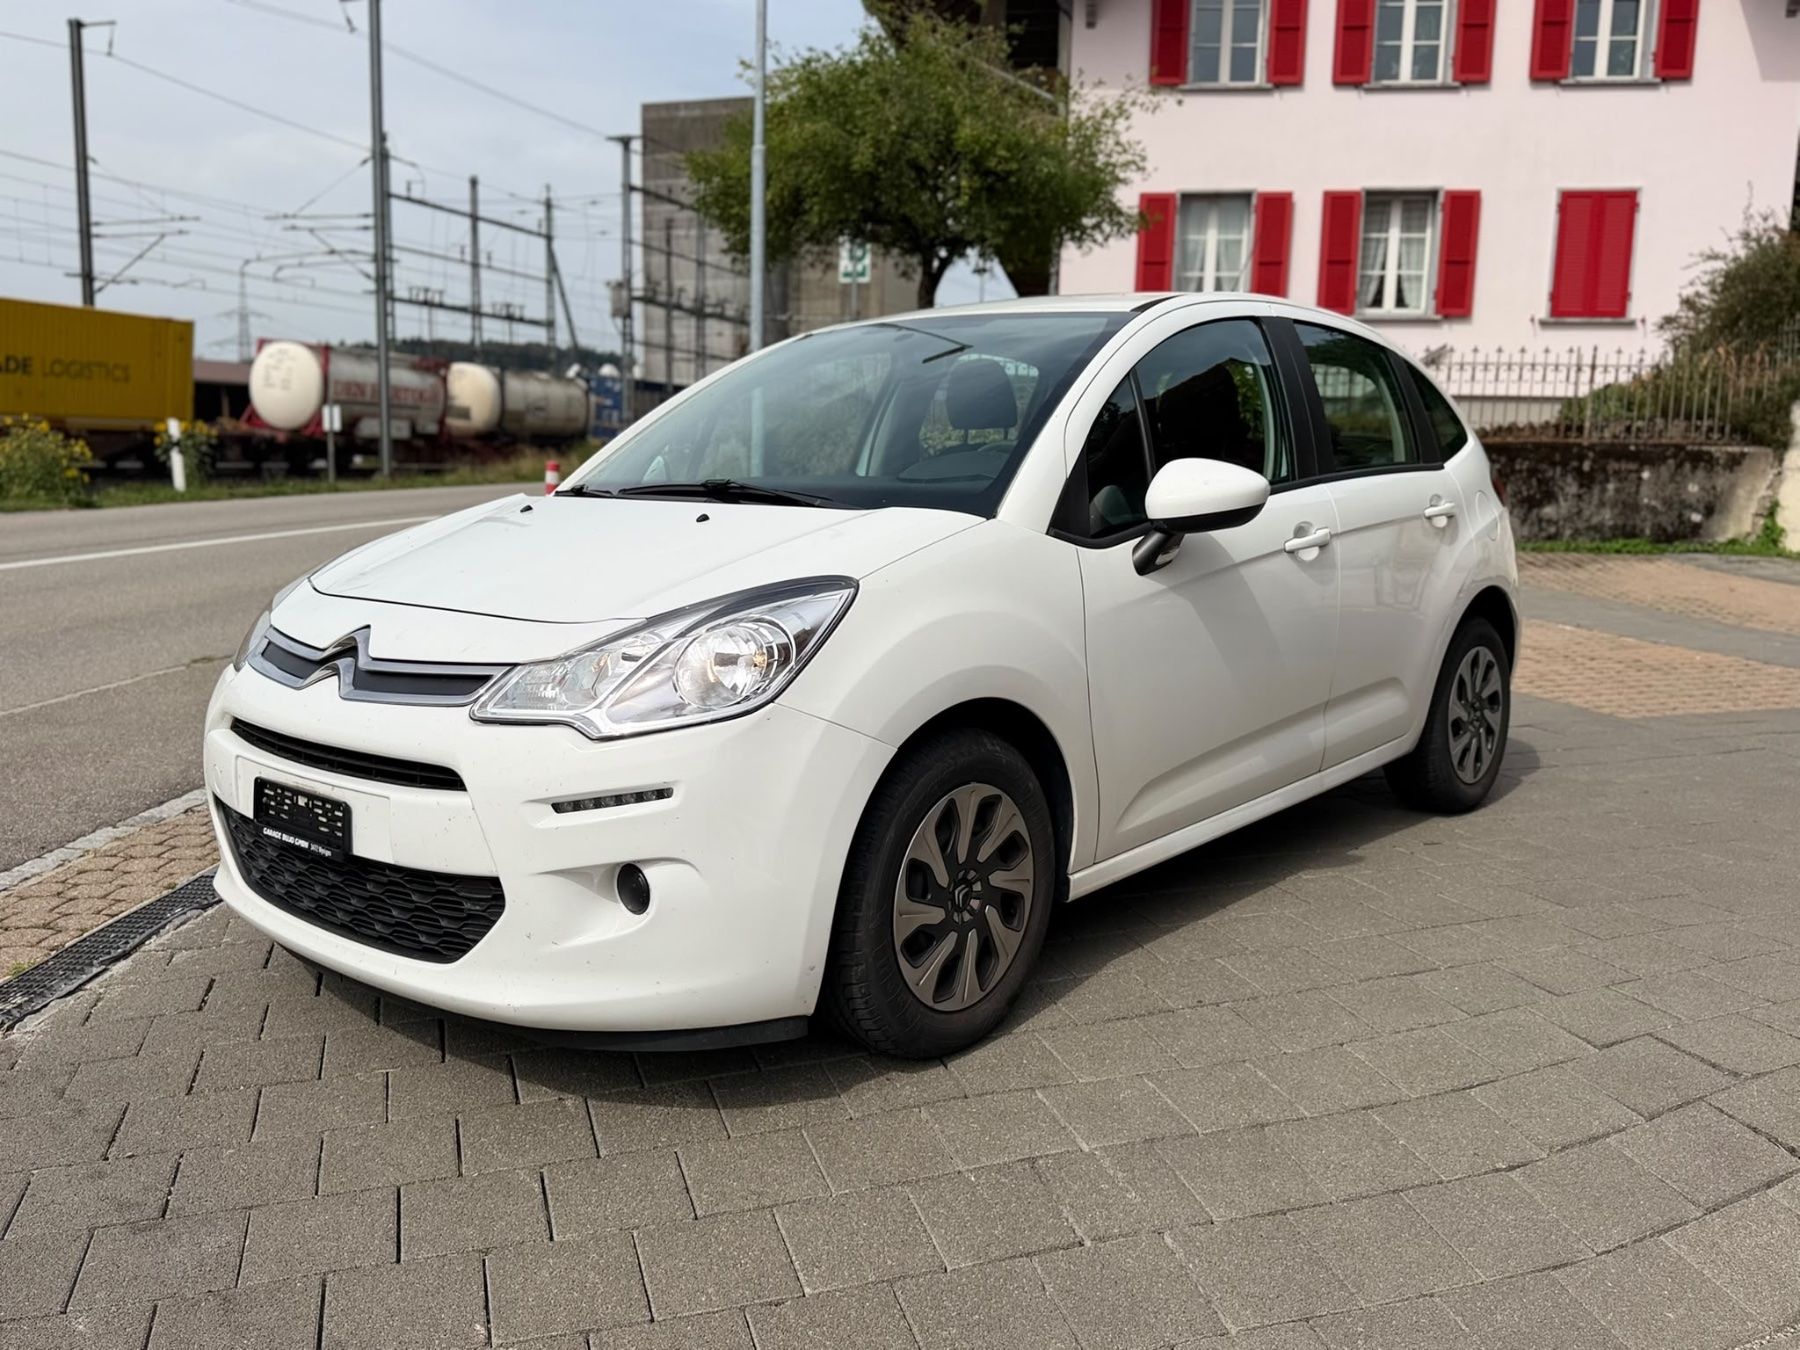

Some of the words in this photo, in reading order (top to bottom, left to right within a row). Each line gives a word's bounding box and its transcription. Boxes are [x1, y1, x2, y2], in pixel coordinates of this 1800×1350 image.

[0, 355, 32, 377] DE
[43, 356, 131, 382] LOGISTICS
[263, 827, 282, 839] GARAGE
